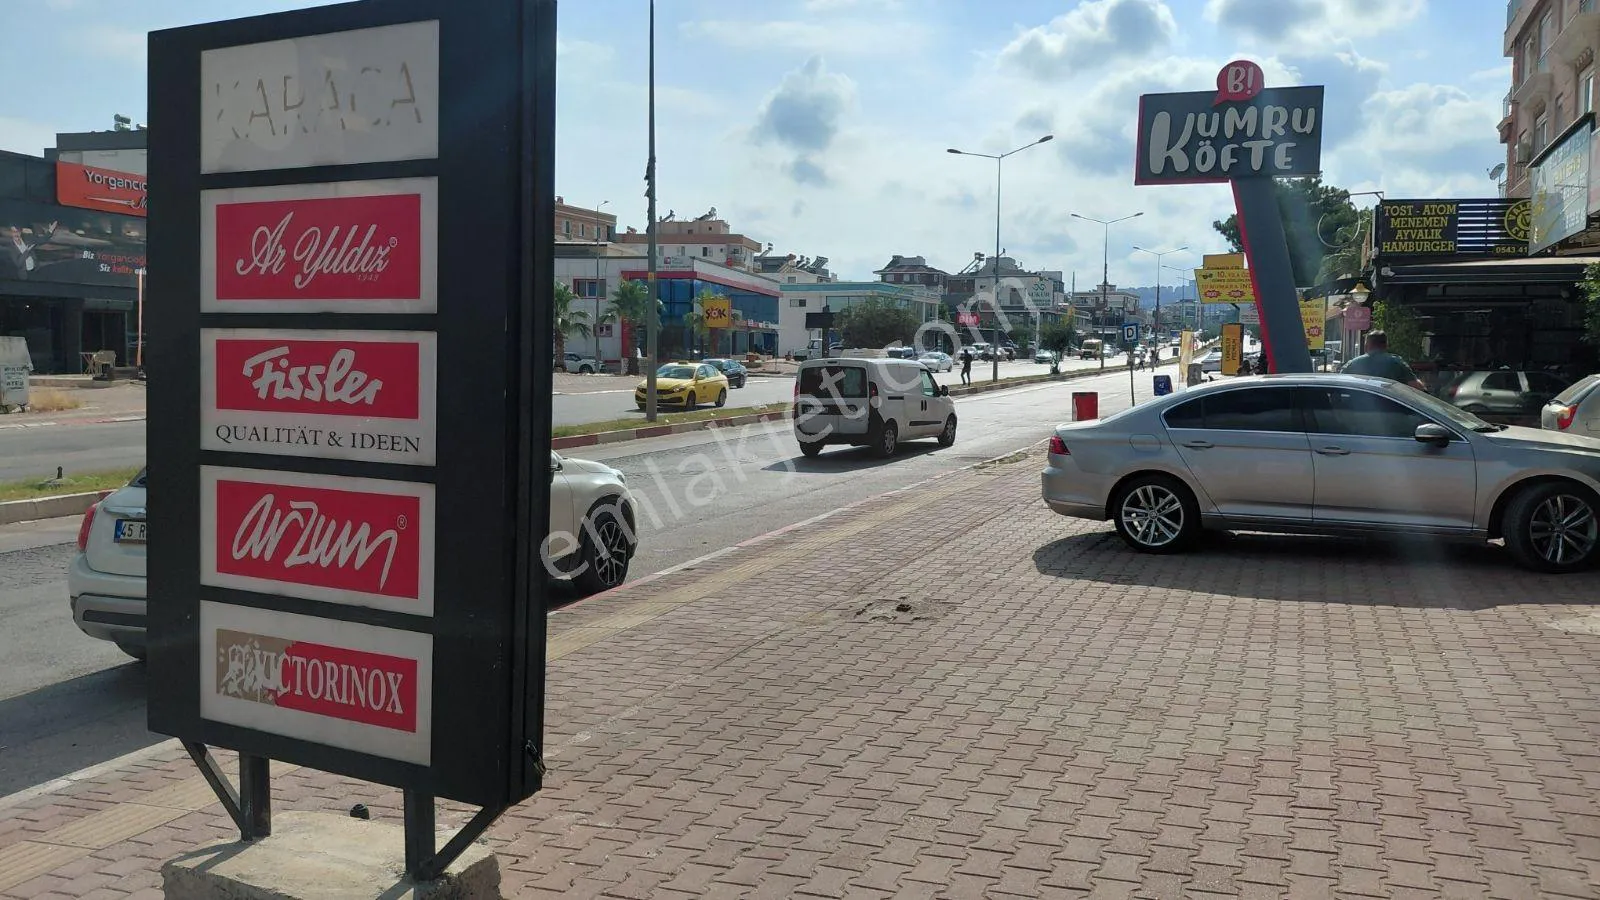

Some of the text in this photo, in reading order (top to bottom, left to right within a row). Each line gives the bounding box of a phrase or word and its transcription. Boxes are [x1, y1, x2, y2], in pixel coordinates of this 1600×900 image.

[1228, 66, 1251, 94] B!
[1384, 205, 1414, 216] TOST
[1422, 204, 1457, 215] ATOM
[1390, 216, 1448, 227] MENEMEN
[1395, 228, 1442, 240] AYVALIK
[236, 211, 294, 275] Ar
[1382, 241, 1455, 252] HAMBURGER
[1126, 327, 1134, 339] D
[242, 346, 383, 405] Fissler
[216, 423, 421, 452] QUALITÄT & IDEEN
[120, 526, 133, 537] 45
